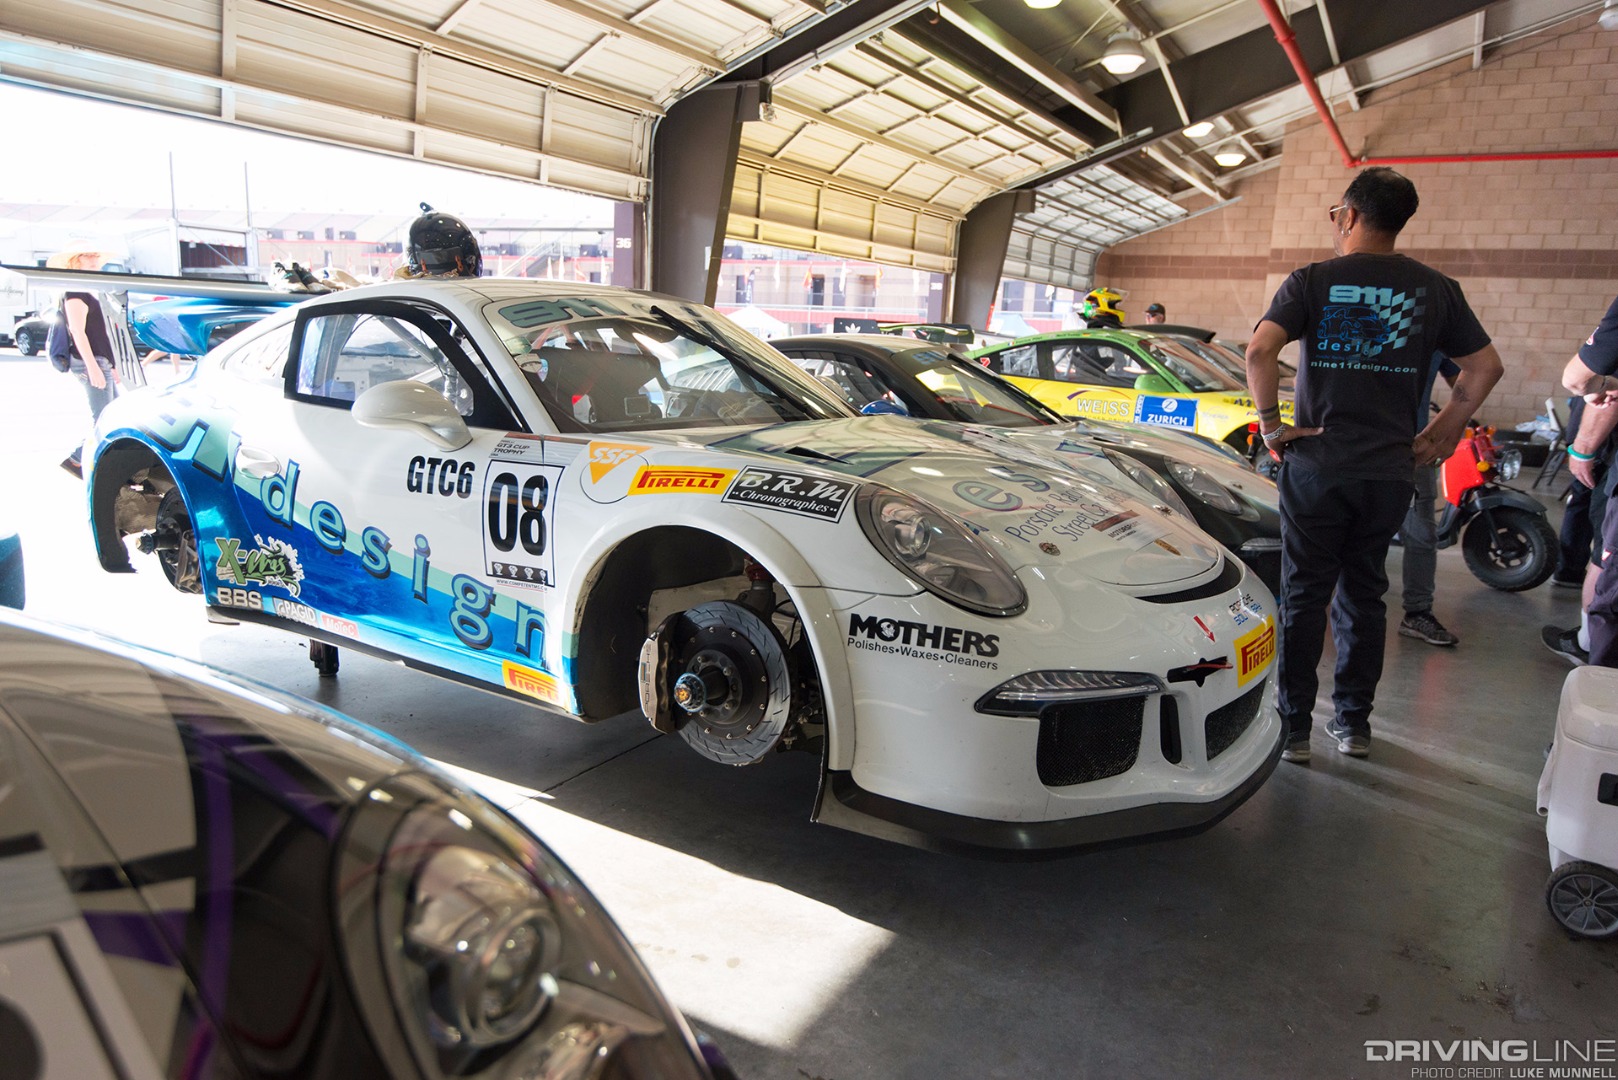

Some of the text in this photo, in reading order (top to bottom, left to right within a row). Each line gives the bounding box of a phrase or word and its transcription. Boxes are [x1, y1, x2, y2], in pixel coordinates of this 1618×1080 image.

[616, 238, 632, 248] 36
[1329, 285, 1393, 306] 911
[1317, 339, 1383, 356] design
[1310, 360, 1418, 374] nine11design.com
[1076, 399, 1130, 417] WEISS
[1146, 413, 1188, 426] ZURICH
[588, 447, 639, 466] SSF
[407, 455, 475, 499] GTC6
[636, 470, 726, 489] PIRELLI
[488, 472, 549, 556] 08
[1004, 502, 1064, 543] Porsche
[1052, 511, 1099, 542] Street
[217, 587, 262, 606] BBS
[284, 602, 317, 623] PAGID
[848, 613, 1000, 657] MOTHERS
[1240, 625, 1275, 676] PIRELLI
